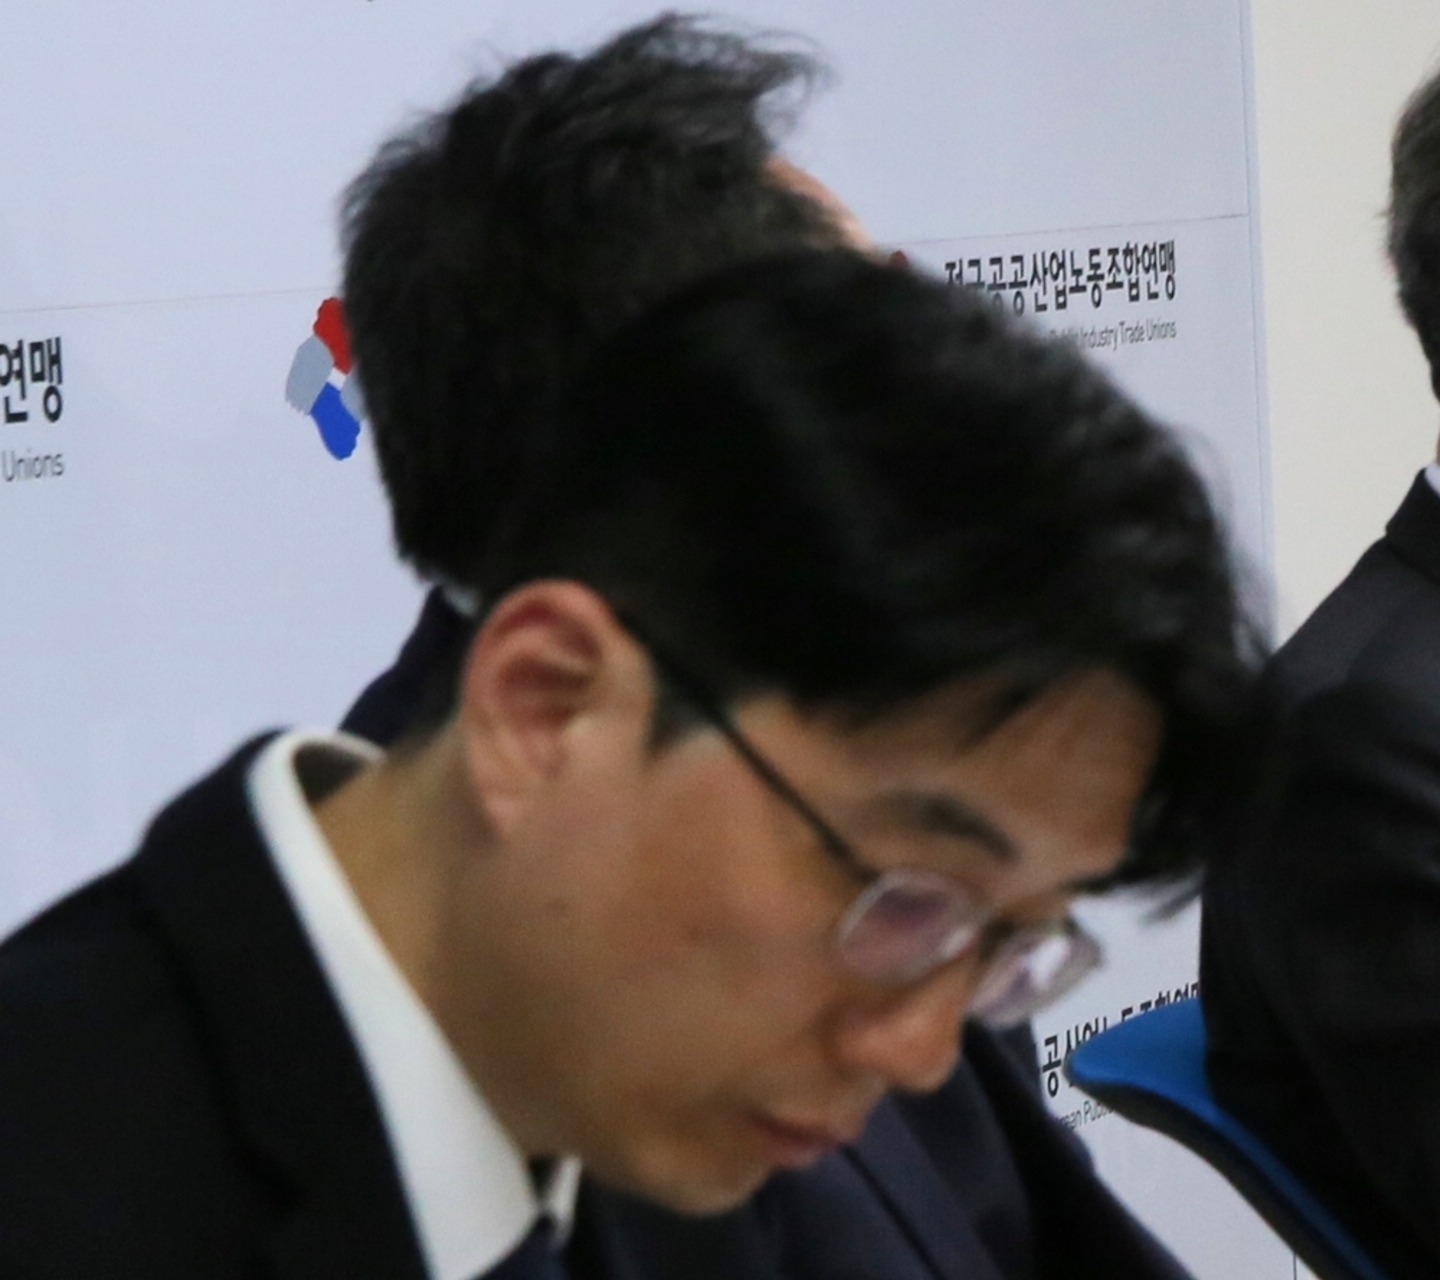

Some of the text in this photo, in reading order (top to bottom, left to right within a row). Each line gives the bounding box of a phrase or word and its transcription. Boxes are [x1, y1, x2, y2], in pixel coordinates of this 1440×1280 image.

[1119, 320, 1145, 345] Trade
[1146, 316, 1178, 341] Unions
[0, 336, 63, 423] 연맹
[1, 447, 66, 483] Unions
